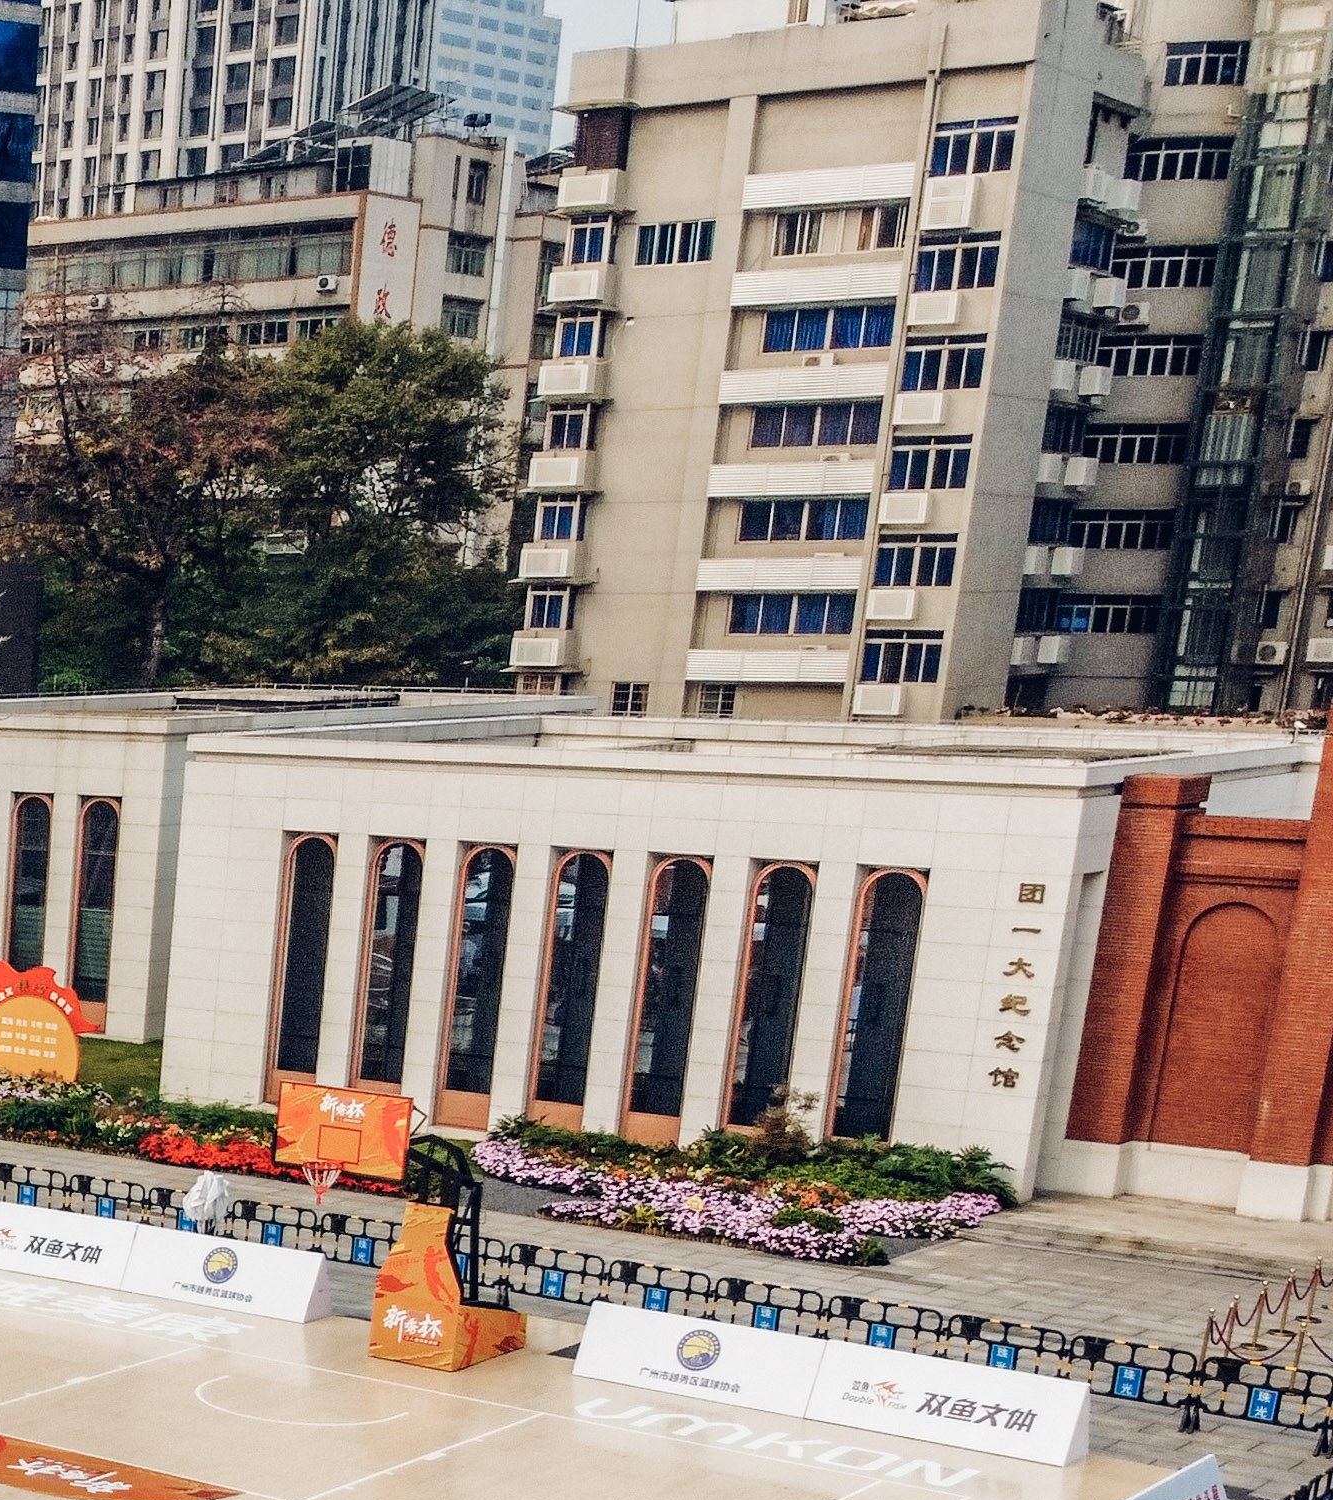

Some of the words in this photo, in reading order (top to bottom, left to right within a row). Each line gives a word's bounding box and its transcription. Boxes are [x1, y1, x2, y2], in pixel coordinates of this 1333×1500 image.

[987, 882, 1046, 1088] 团一大纪念馆
[24, 1234, 103, 1264] 双鱼文体
[382, 1305, 443, 1343] 新秀杯
[637, 1366, 742, 1394] 广州市越秀区篮球协会
[1121, 1367, 1137, 1395] 珠光
[842, 1392, 875, 1407] Double
[915, 1392, 1038, 1433] 双鱼文体
[1255, 1389, 1271, 1419] 珠光
